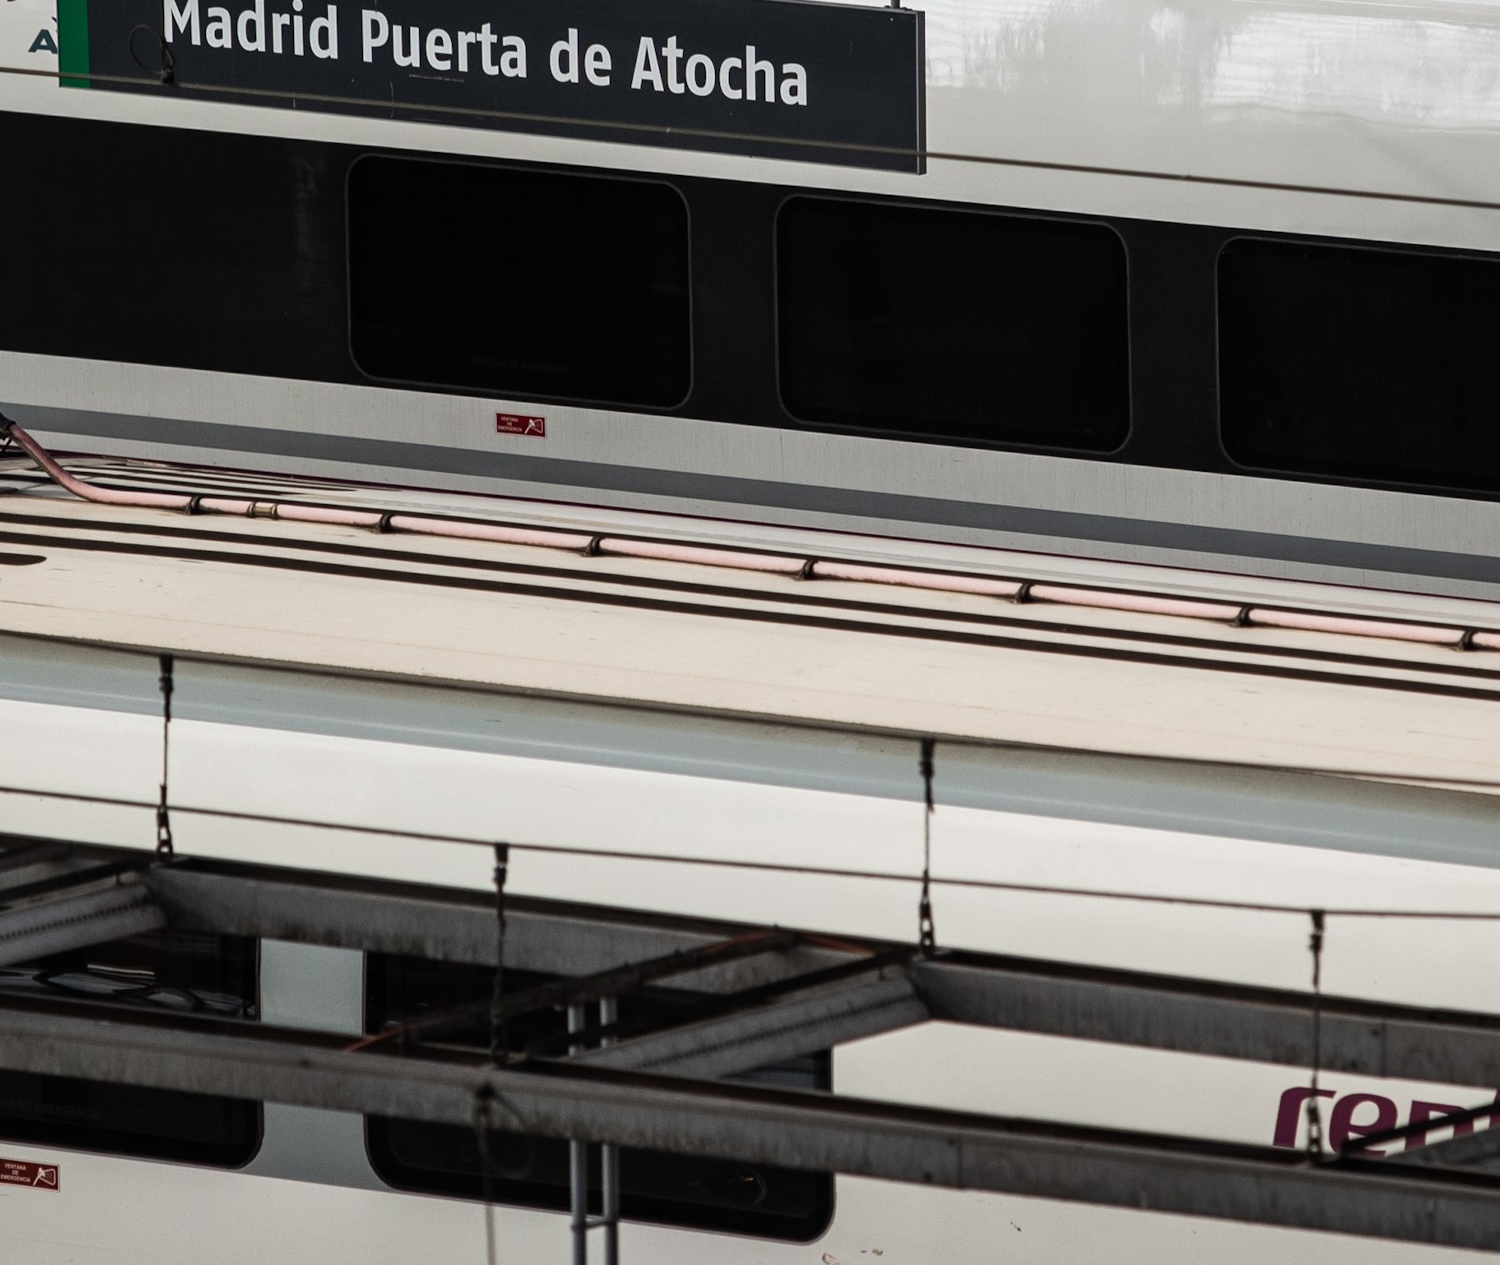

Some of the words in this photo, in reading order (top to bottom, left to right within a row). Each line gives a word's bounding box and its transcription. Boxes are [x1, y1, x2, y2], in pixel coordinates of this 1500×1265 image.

[361, 10, 528, 78] Puerta
[550, 28, 612, 87] de
[631, 35, 809, 106] Atocha
[4, 1163, 27, 1171] VENTANA
[0, 1174, 31, 1182] EMERGENCIA
